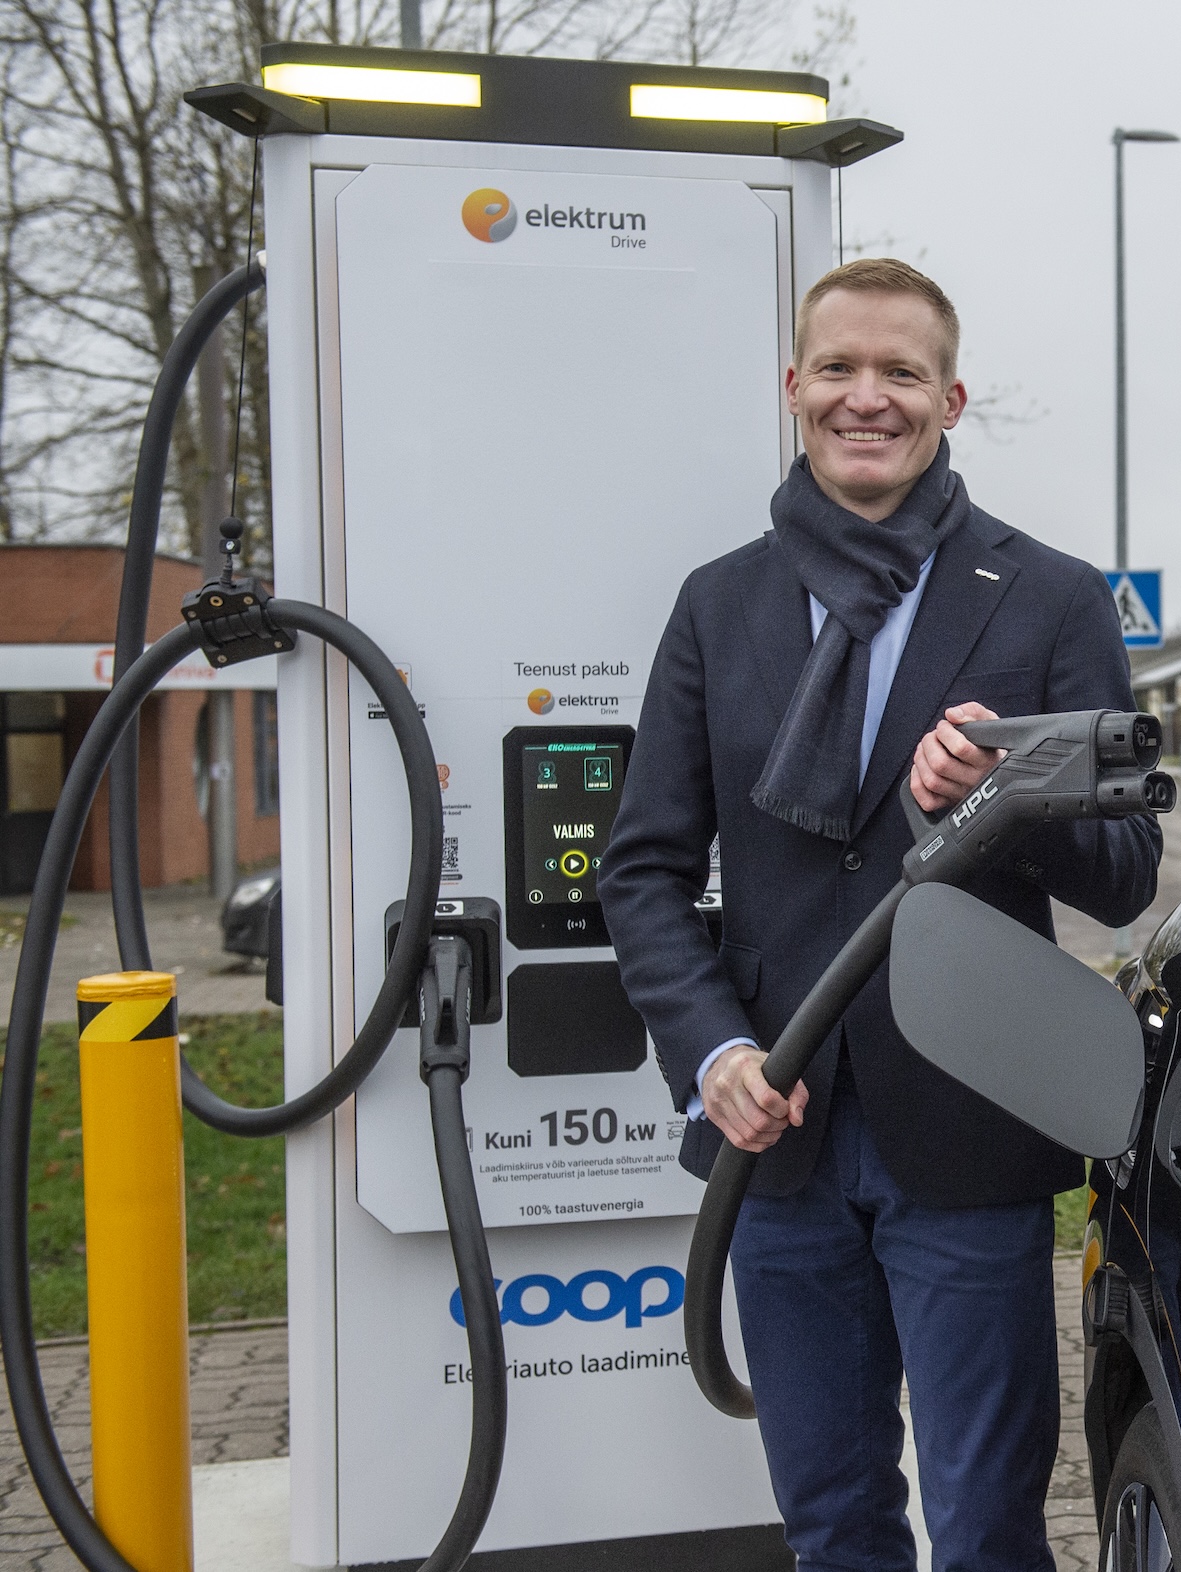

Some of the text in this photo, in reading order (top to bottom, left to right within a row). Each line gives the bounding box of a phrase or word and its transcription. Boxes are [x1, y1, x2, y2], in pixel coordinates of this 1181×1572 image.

[525, 203, 646, 231] elektrum
[611, 235, 647, 249] Drive
[513, 660, 630, 679] Teenust pakub
[558, 694, 619, 706] elektrum
[543, 768, 551, 778] 3
[594, 767, 601, 777] 4
[952, 777, 998, 828] HPC
[553, 824, 595, 839] VALMIS
[485, 1107, 657, 1150] Kuni 150 kW
[479, 1154, 675, 1174] Laadimiskiirus võib varieeruda sõltuvalt auto
[492, 1165, 662, 1183] aku temperatuurist ja laetuse tasemest
[519, 1199, 644, 1217] 100% taastuvenergia
[444, 1348, 690, 1385] Eleiauto laadimine
